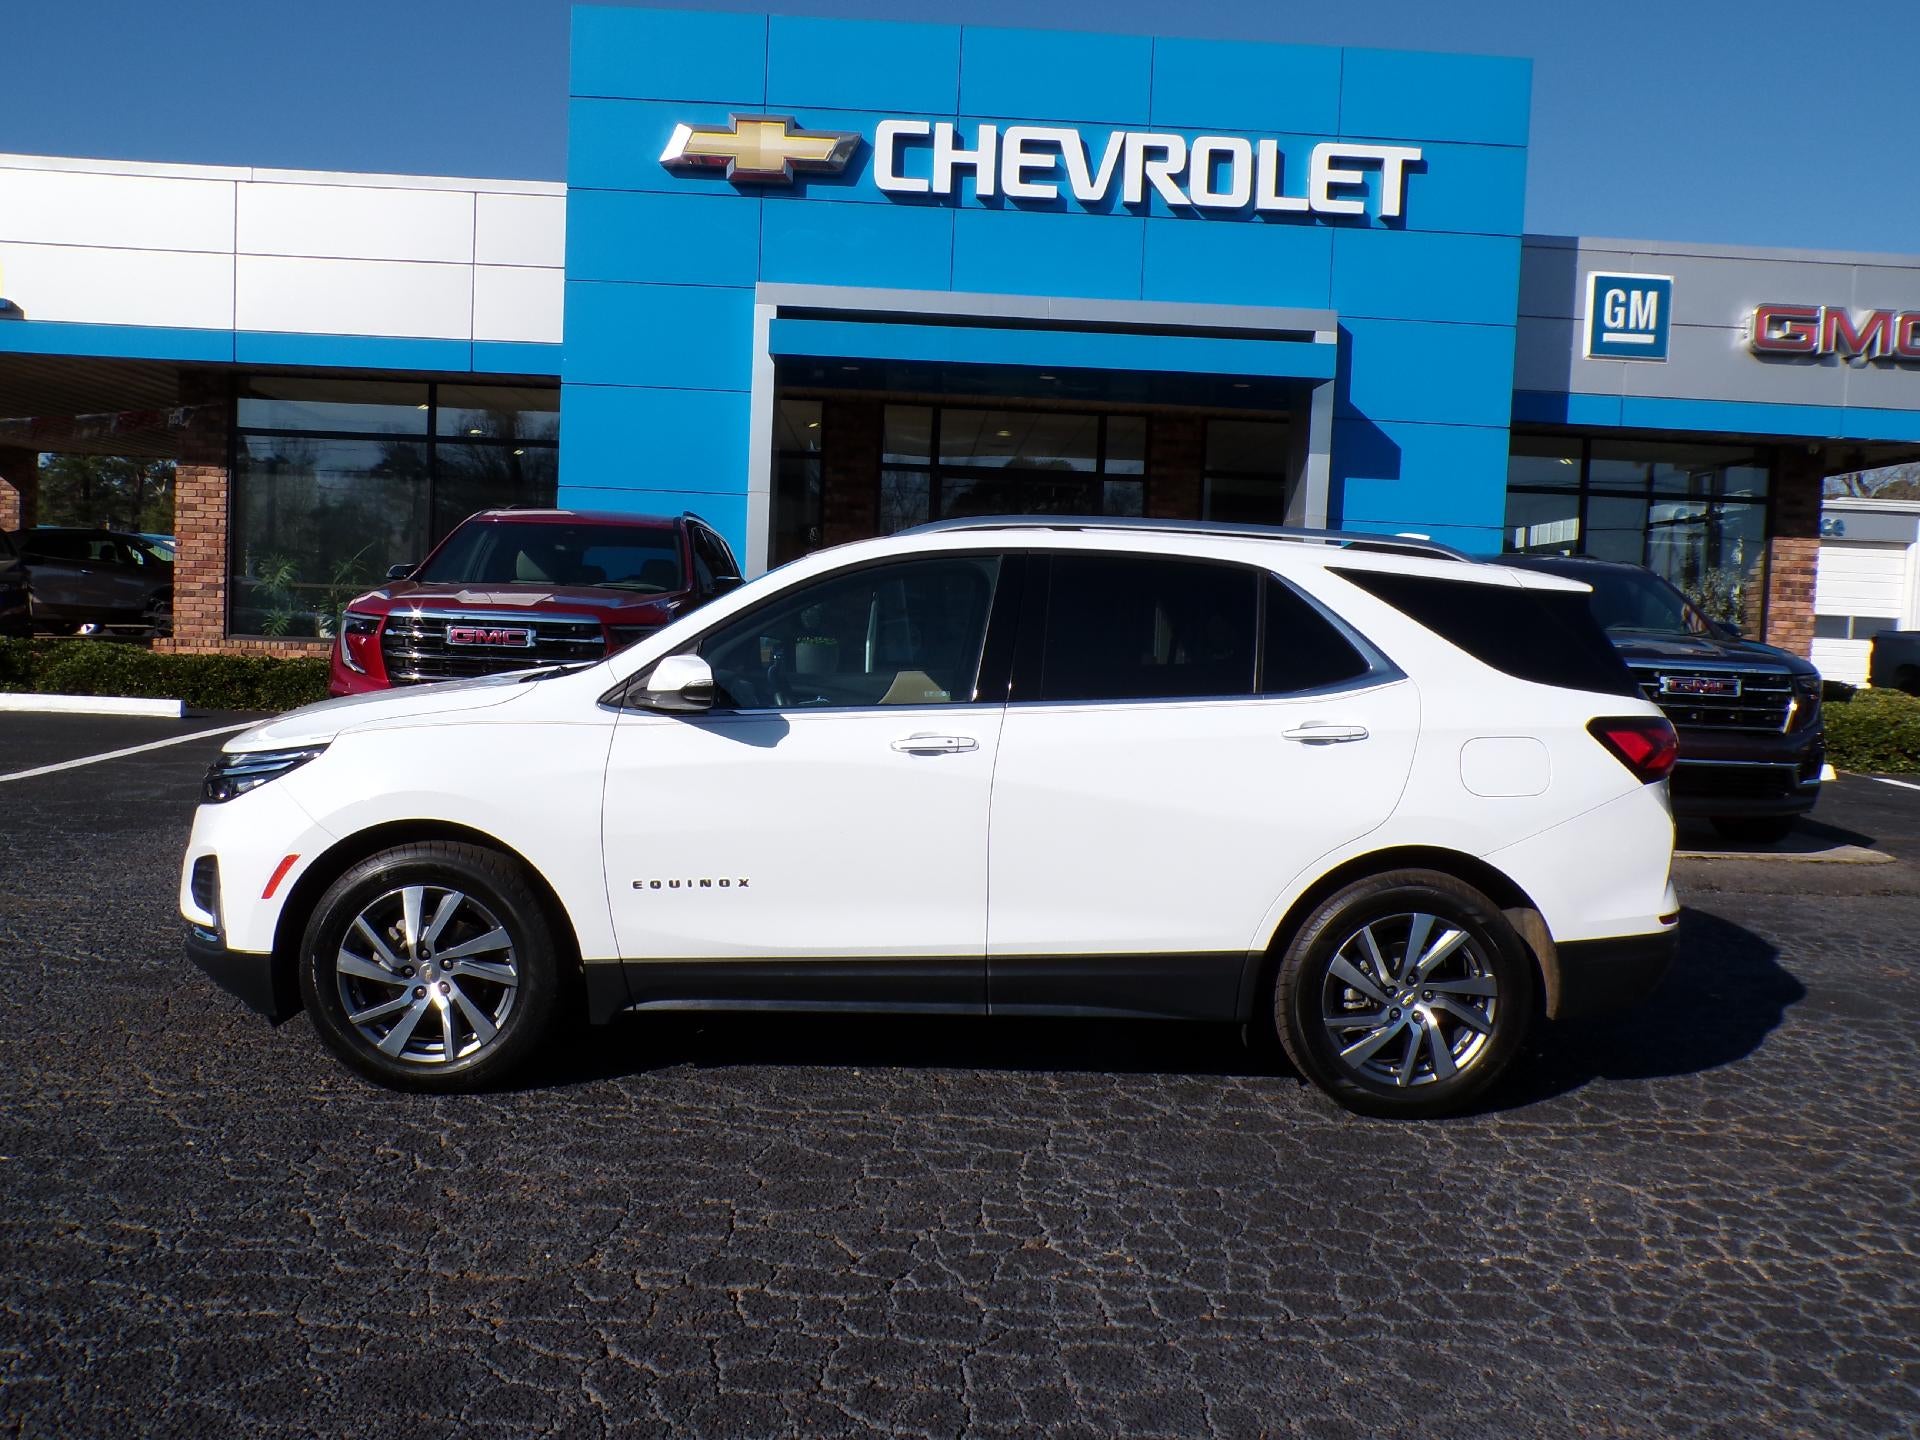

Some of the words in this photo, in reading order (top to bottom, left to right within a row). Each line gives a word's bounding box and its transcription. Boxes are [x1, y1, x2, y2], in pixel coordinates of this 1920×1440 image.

[874, 119, 1422, 217] CHEVROLET
[1603, 288, 1658, 330] GM
[451, 628, 528, 646] GMC
[632, 878, 750, 890] EQUINOX
